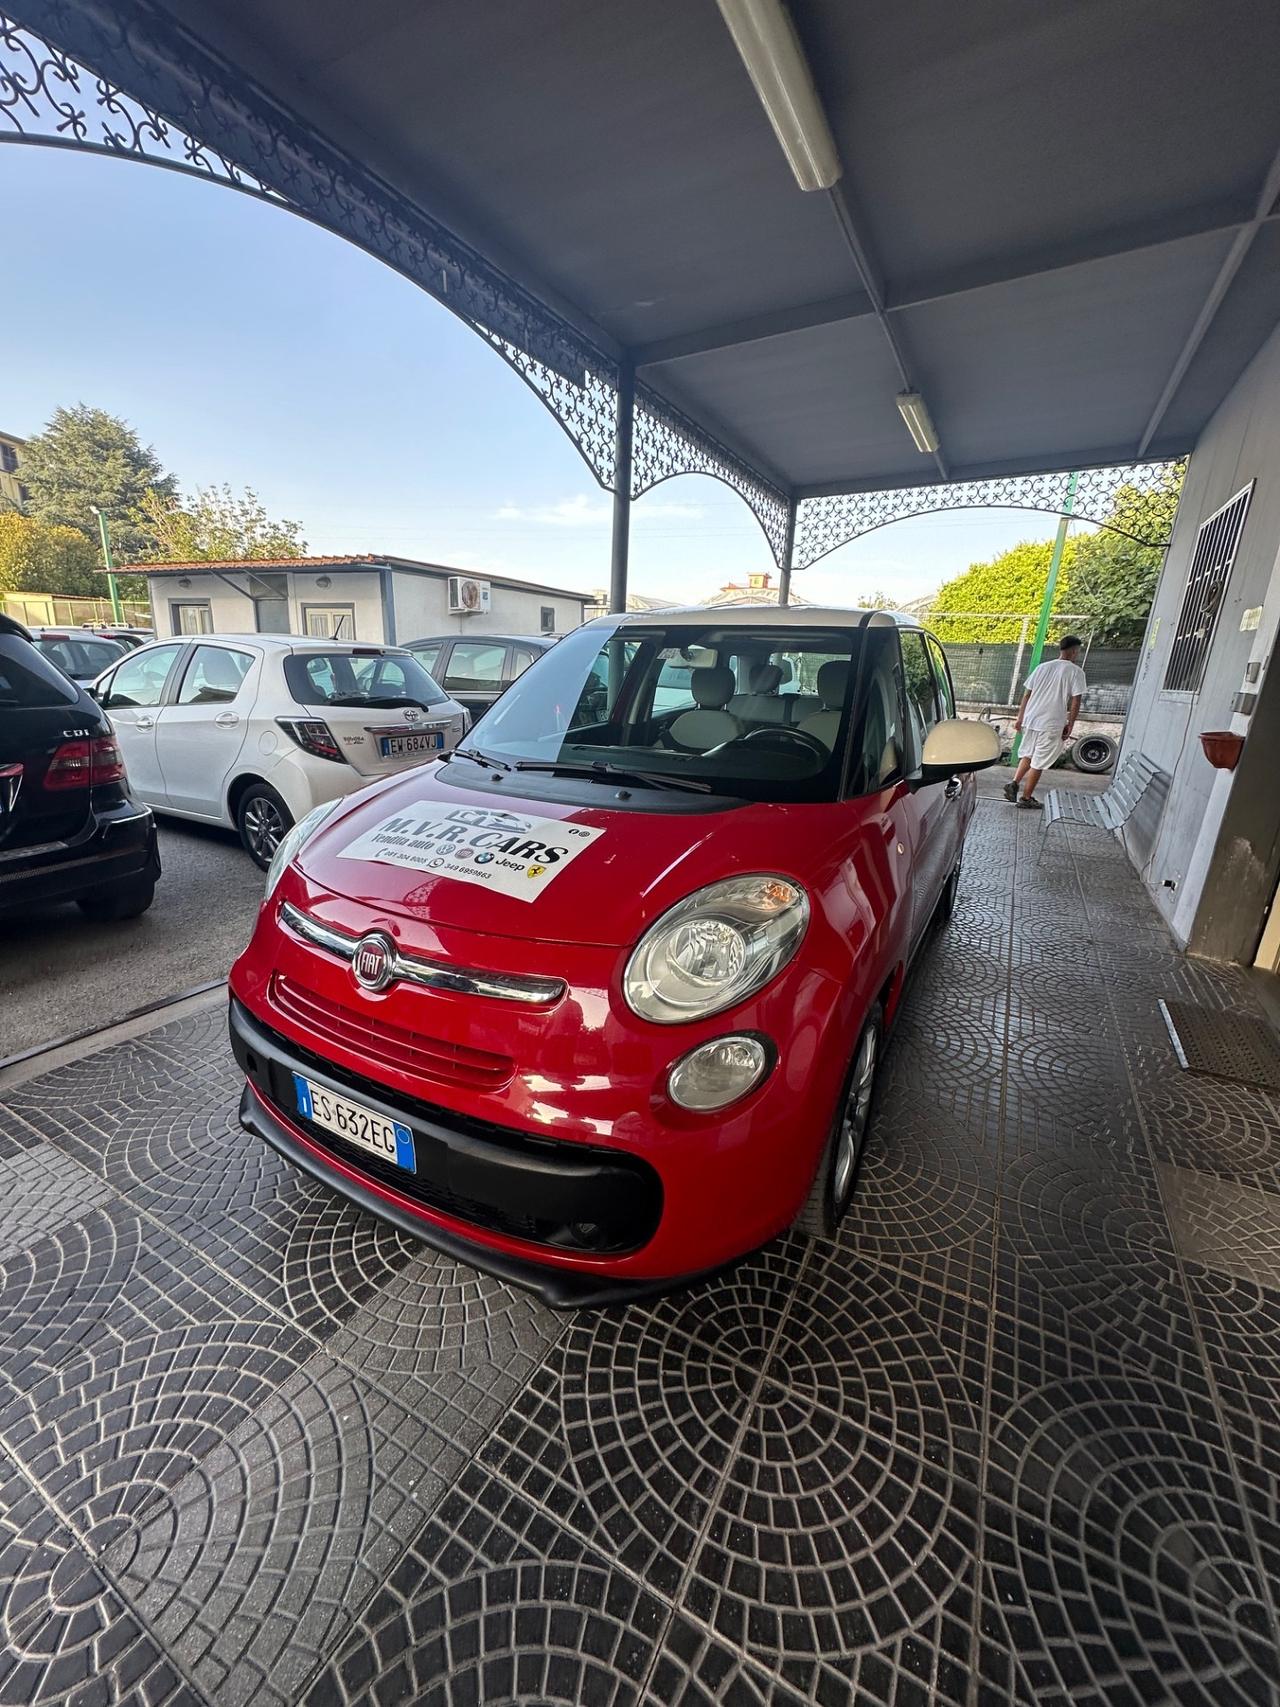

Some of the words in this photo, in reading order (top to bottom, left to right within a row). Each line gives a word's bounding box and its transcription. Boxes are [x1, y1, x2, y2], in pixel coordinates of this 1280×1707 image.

[62, 728, 90, 738] CDI
[390, 740, 404, 754] EW
[406, 735, 437, 751] 684VJ
[407, 840, 435, 850] auto
[444, 863, 460, 871] 349
[495, 858, 525, 871] Jeep
[360, 951, 382, 975] FIAT
[310, 1089, 332, 1122] ES
[335, 1103, 396, 1154] 632EG
